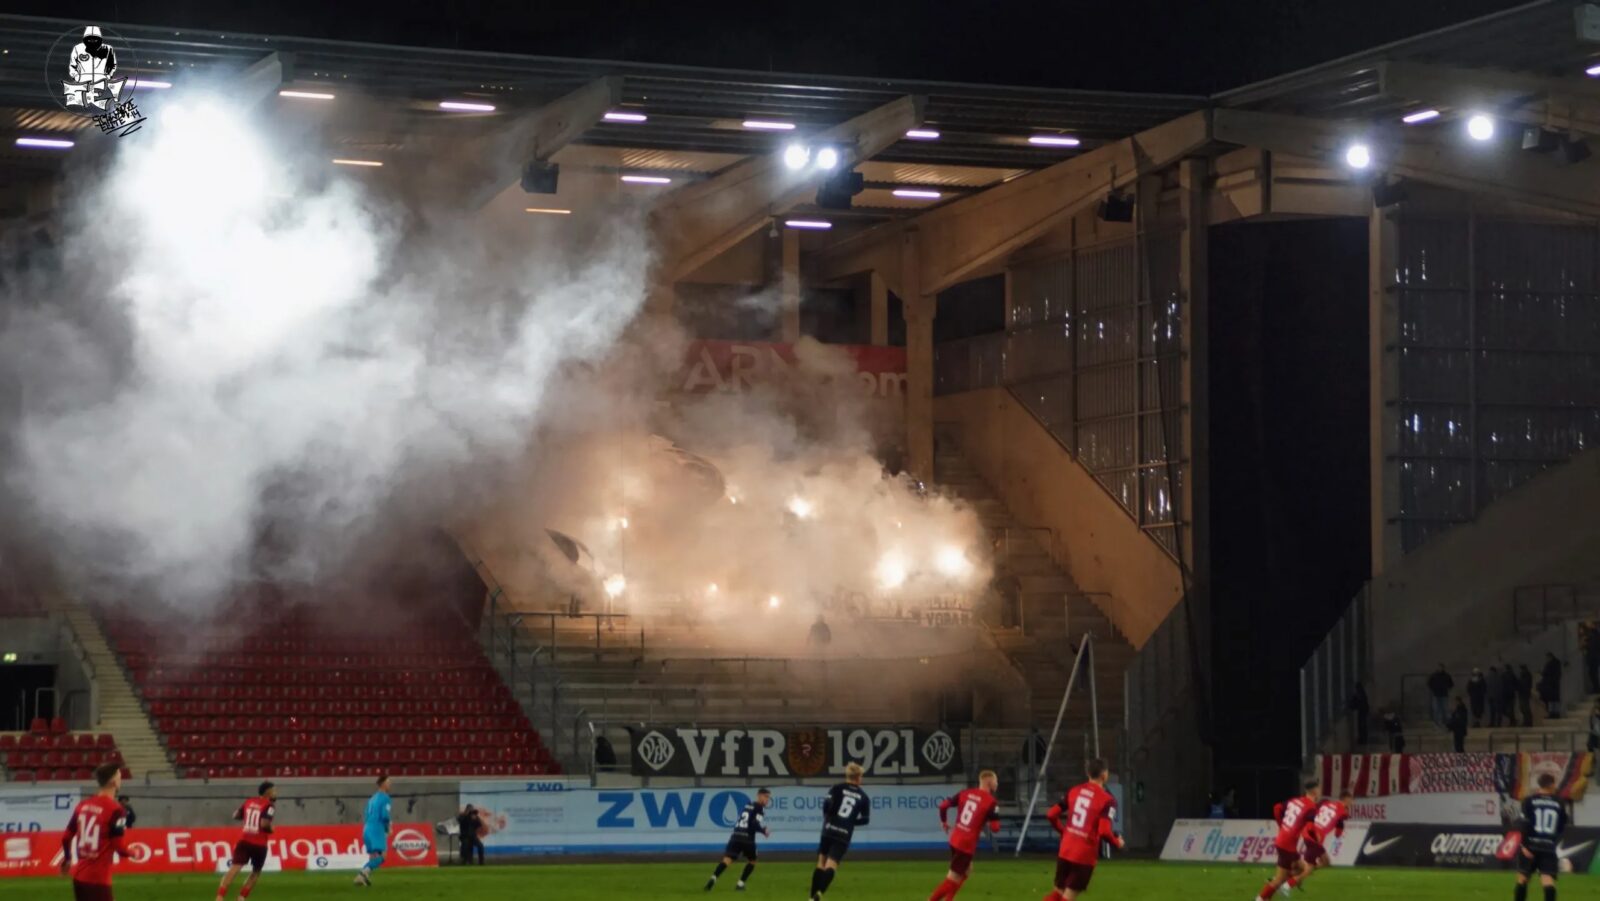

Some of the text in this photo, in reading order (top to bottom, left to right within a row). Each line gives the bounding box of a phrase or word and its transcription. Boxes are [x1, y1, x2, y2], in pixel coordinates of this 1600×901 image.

[677, 728, 789, 775] VfR
[828, 728, 919, 774] 1921
[526, 782, 564, 792] ZWO
[597, 790, 753, 829] ZWO
[838, 795, 857, 818] 6
[870, 796, 894, 810] ER
[902, 795, 943, 811] REGIO
[960, 801, 977, 826] 6
[1072, 795, 1091, 828] 5
[78, 813, 100, 851] 14
[244, 807, 261, 833] 10
[1534, 807, 1559, 834] 10
